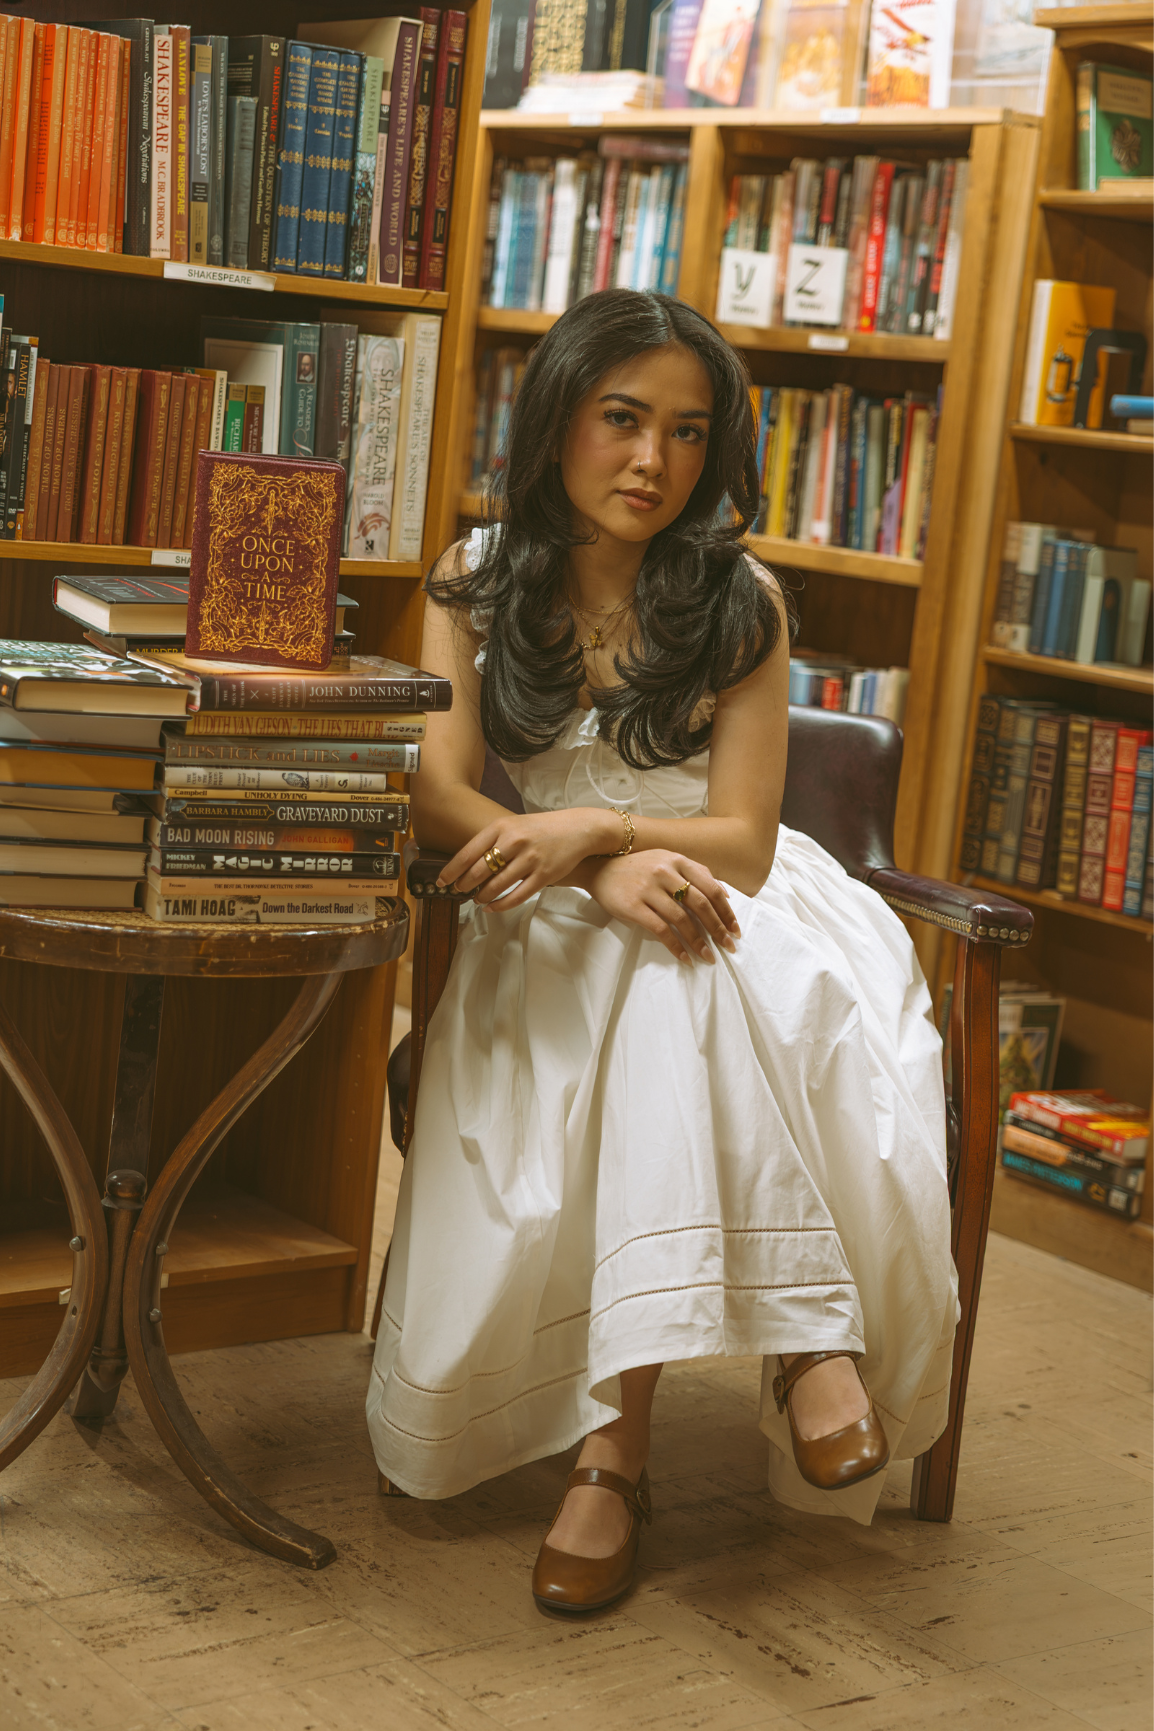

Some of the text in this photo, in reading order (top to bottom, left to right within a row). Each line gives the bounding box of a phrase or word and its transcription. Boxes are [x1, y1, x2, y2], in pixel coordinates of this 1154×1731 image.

[142, 72, 152, 130] Shakespearean
[201, 81, 210, 112] LOVE'S
[366, 68, 378, 142] SHAKESPEARE
[4, 103, 12, 140] Coriolanus
[20, 105, 28, 132] Pericles
[66, 109, 75, 130] Love's
[74, 111, 83, 131] Henry
[95, 115, 104, 134] Henry
[178, 105, 186, 121] THE
[64, 133, 73, 161] Labour's
[156, 40, 170, 240] SHAKESPEARE M.C. BRADBROOK
[178, 124, 187, 142] GAP
[200, 114, 209, 151] LABOR'S
[387, 36, 413, 246] SHAKESPEARE'S LIFE AND WORLD
[83, 147, 91, 170] Athens
[178, 144, 186, 153] IN
[260, 66, 280, 265] SHAKESPEARE & THE QUESTION OF THEORY
[177, 155, 186, 216] SHAKESPEARE
[188, 268, 252, 284] SHAKESPEARE
[796, 259, 822, 295] Z
[17, 354, 29, 398] HAMLET
[338, 338, 356, 427] Shakespeare
[216, 377, 224, 425] SHAKESPEARE'S
[297, 389, 305, 427] GUIDE TO
[305, 395, 313, 431] READER'S
[112, 411, 121, 437] KING
[156, 412, 165, 451] HENRY
[232, 418, 241, 452] RICHAR
[372, 369, 394, 486] SHAKESPEARE
[405, 356, 426, 512] SHAKESPEARE'S SONNETS
[44, 446, 52, 460] OF
[55, 447, 63, 461] OF
[91, 420, 105, 493] KING JOHN
[108, 441, 118, 488] RICHARD
[180, 430, 191, 494] CYMBELINE
[41, 463, 50, 494] TIMON
[52, 464, 61, 495] TIMON
[64, 471, 74, 512] TROILUS
[165, 462, 175, 501] RICHARD
[242, 535, 295, 556] ONCE
[241, 553, 294, 572] UPON
[261, 572, 270, 582] A
[244, 582, 287, 601] TIME
[310, 686, 411, 697] JOHN DUNNING
[193, 715, 230, 735] JUDITH
[234, 716, 254, 734] VAN
[256, 716, 292, 736] GIESON
[298, 718, 319, 736] THE
[321, 719, 342, 737] LIES
[344, 720, 373, 738] THAT
[177, 745, 340, 763] LIPSTICK and LIES
[367, 748, 399, 759] Margit
[231, 808, 268, 816] HAMBLY
[277, 806, 348, 822] GRAVEYARD
[350, 808, 384, 823] DUST
[168, 828, 191, 842] BAD
[196, 829, 230, 844] MOON
[234, 830, 274, 845] RISING
[213, 855, 353, 871] MAGIC MIRROR
[164, 899, 353, 916] TAMI HOAG Down the Darkest Road
